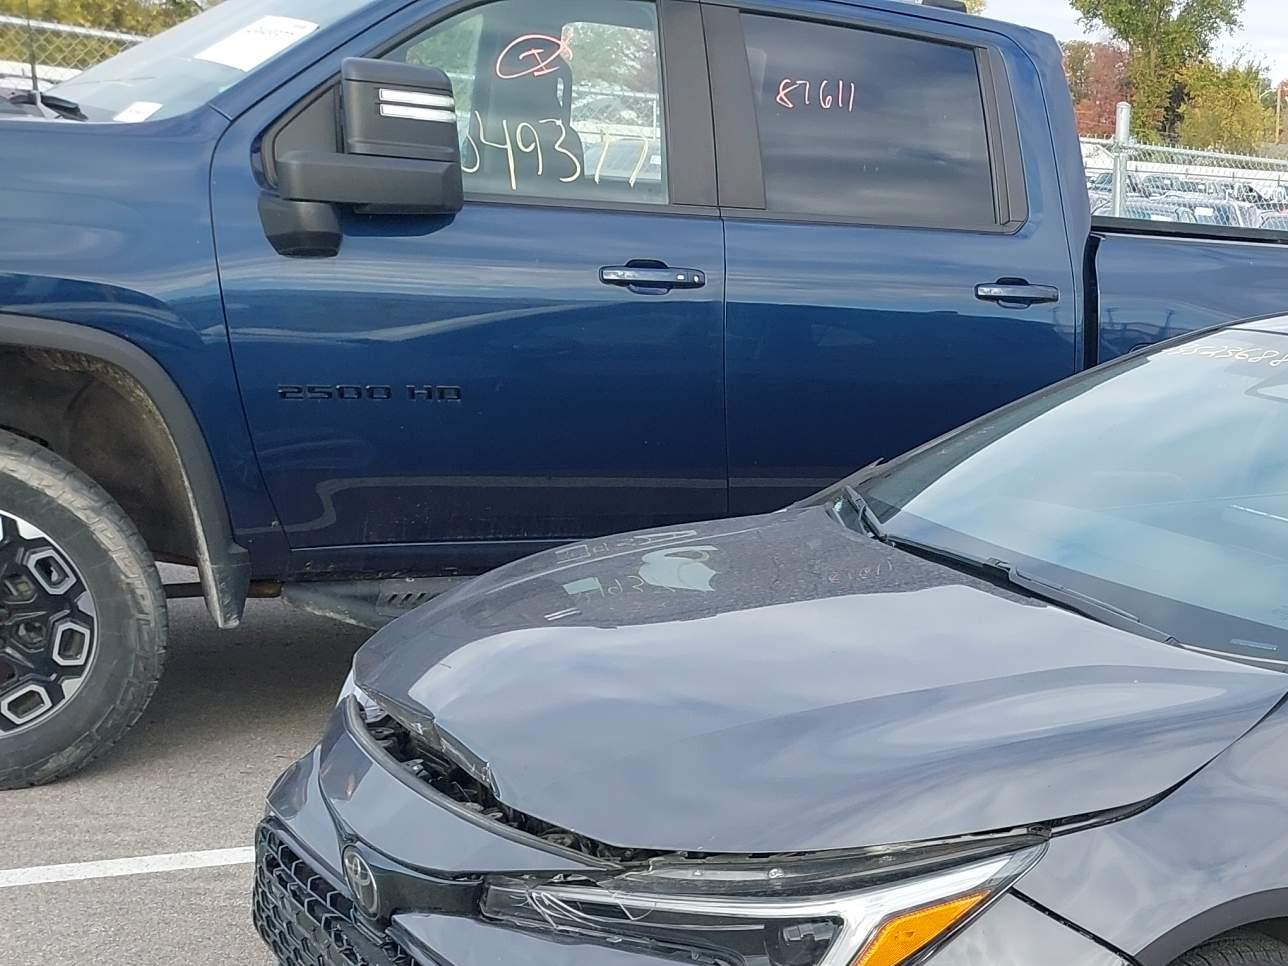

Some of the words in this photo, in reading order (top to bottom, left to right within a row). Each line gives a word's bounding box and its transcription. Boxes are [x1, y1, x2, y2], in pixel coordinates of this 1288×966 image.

[776, 79, 855, 112] 87611
[277, 384, 393, 401] 2500
[405, 384, 464, 402] HD
